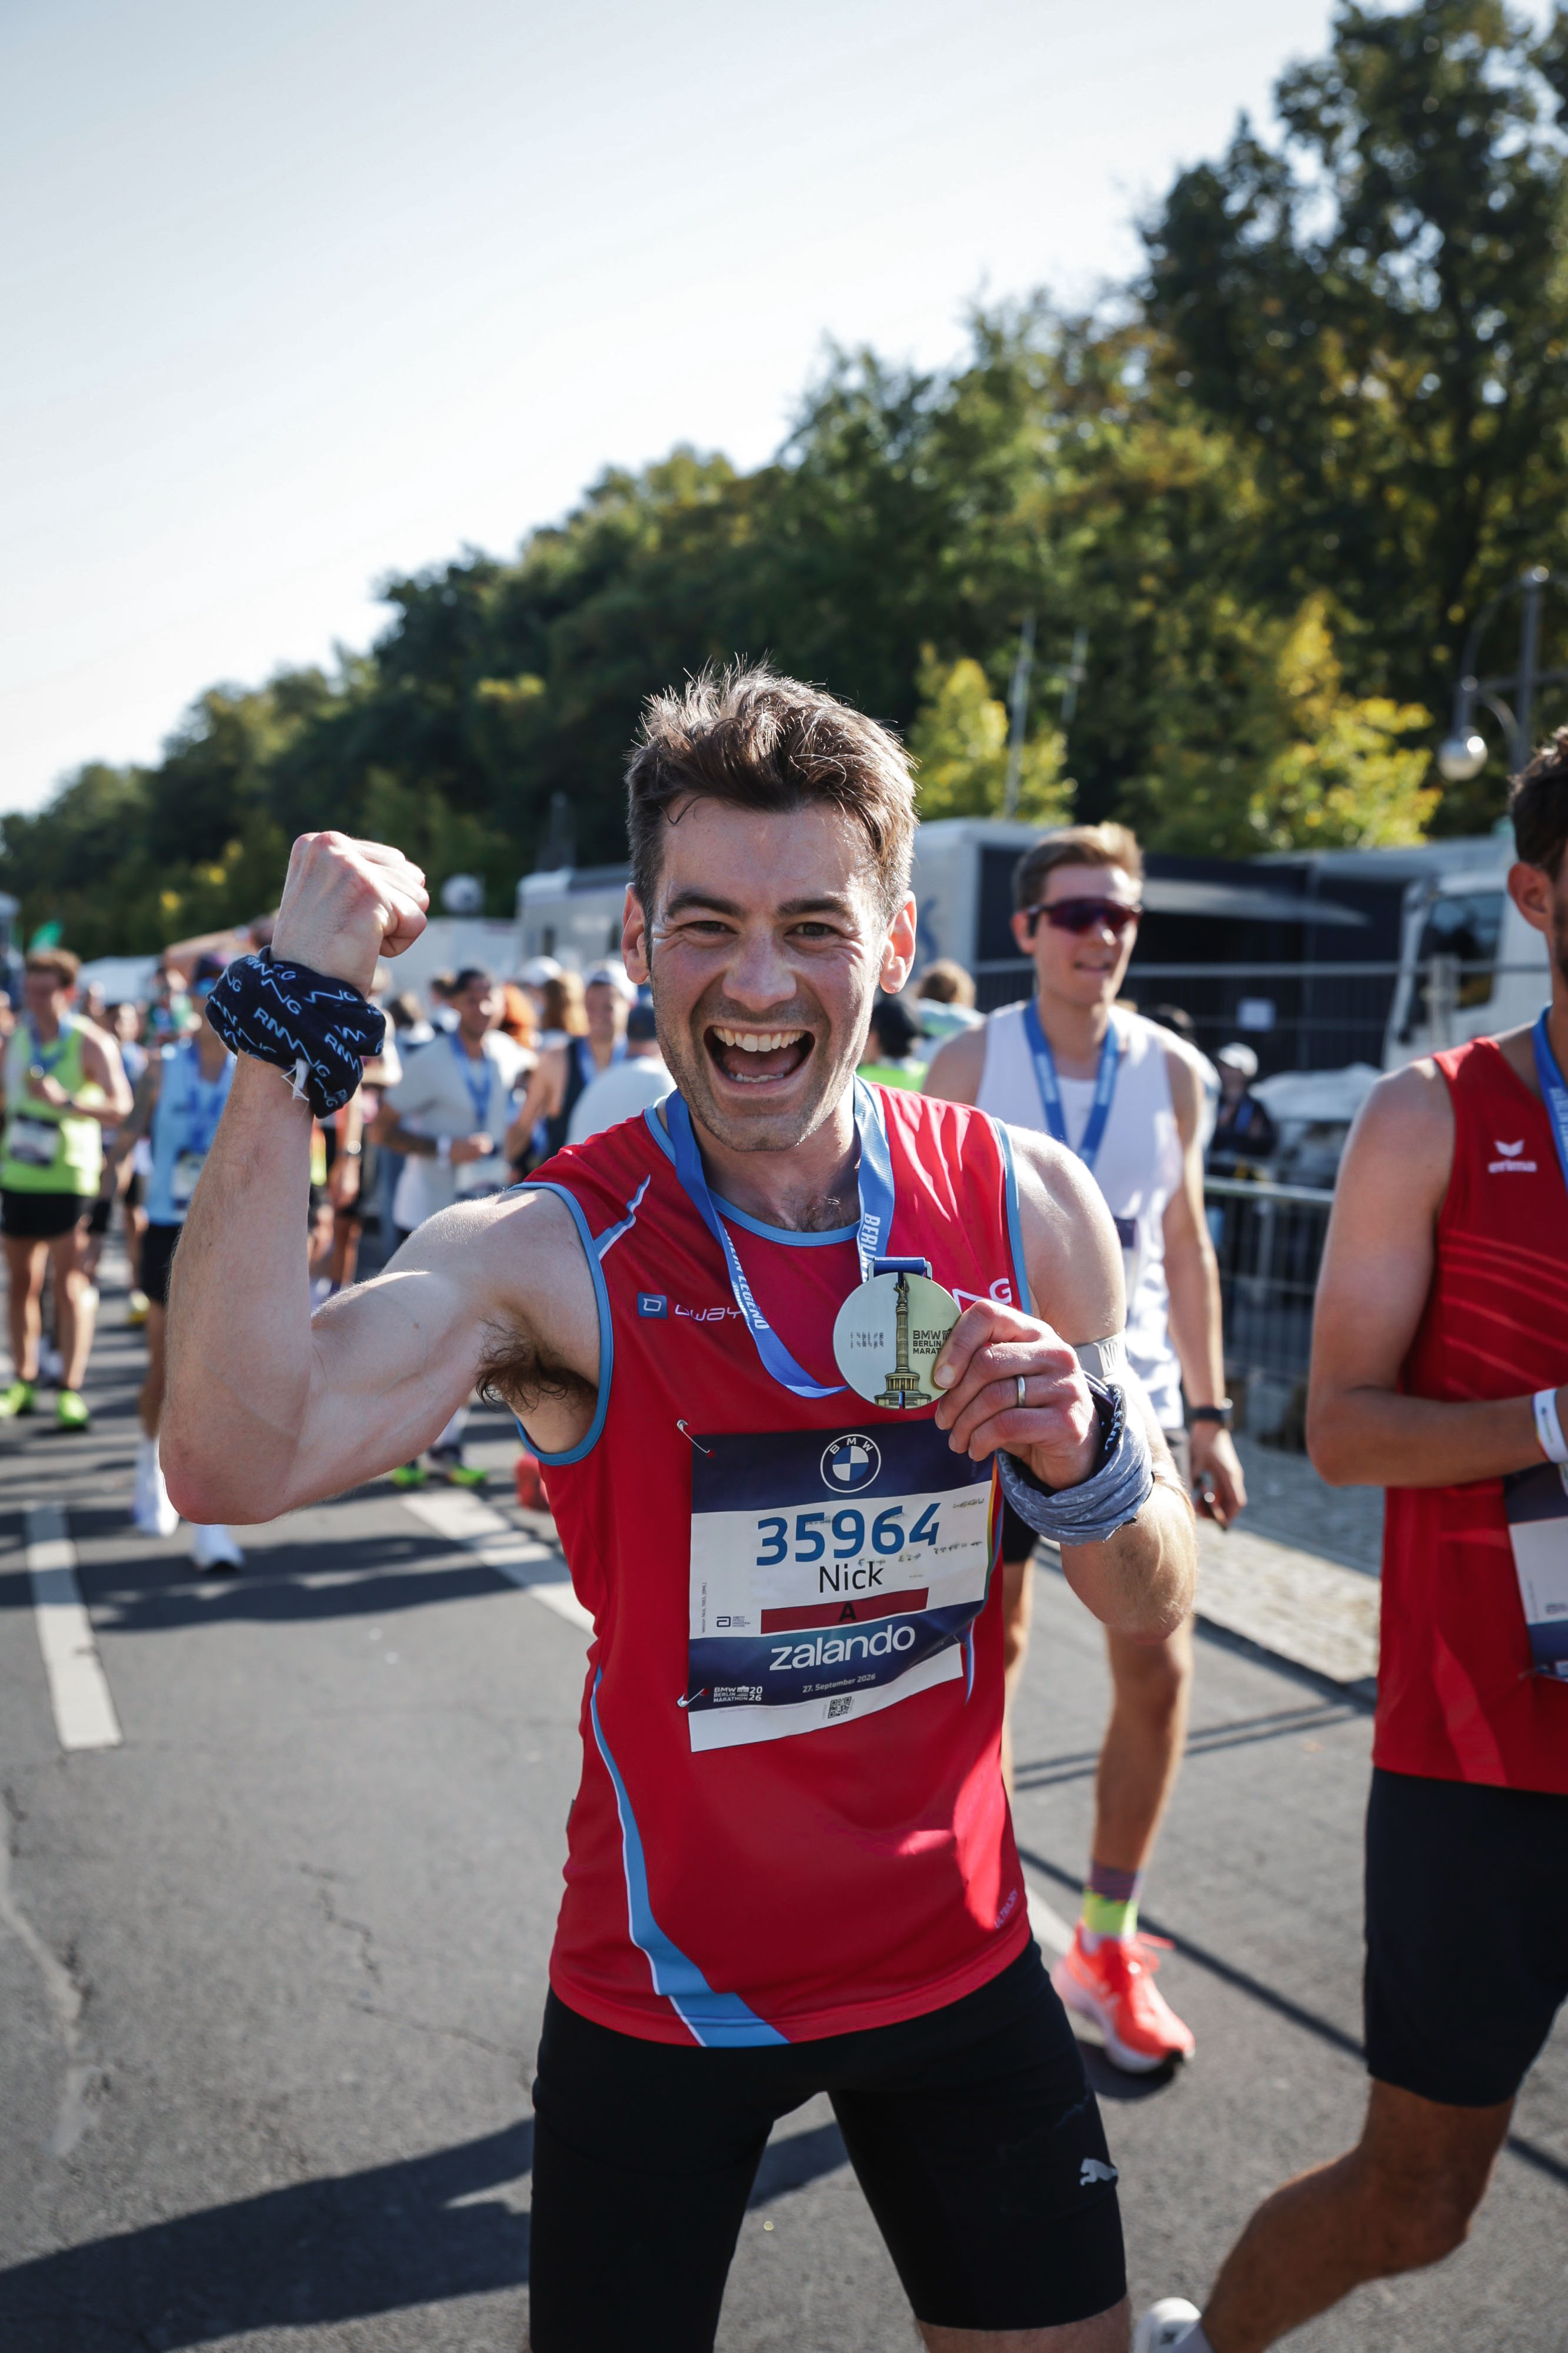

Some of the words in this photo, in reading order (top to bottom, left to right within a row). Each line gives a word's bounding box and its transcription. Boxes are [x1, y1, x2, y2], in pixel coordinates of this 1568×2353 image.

[738, 1275, 770, 1329] LEGEND
[913, 1330, 940, 1339] BMW
[829, 1437, 873, 1454] BMW
[756, 1502, 941, 1566] 35964
[819, 1561, 884, 1592] Nick
[838, 1602, 857, 1622] A
[769, 1625, 915, 1671] zalando
[749, 1686, 763, 1694] 20
[802, 1685, 813, 1693] 27.
[815, 1678, 856, 1691] September
[857, 1674, 876, 1682] 2026
